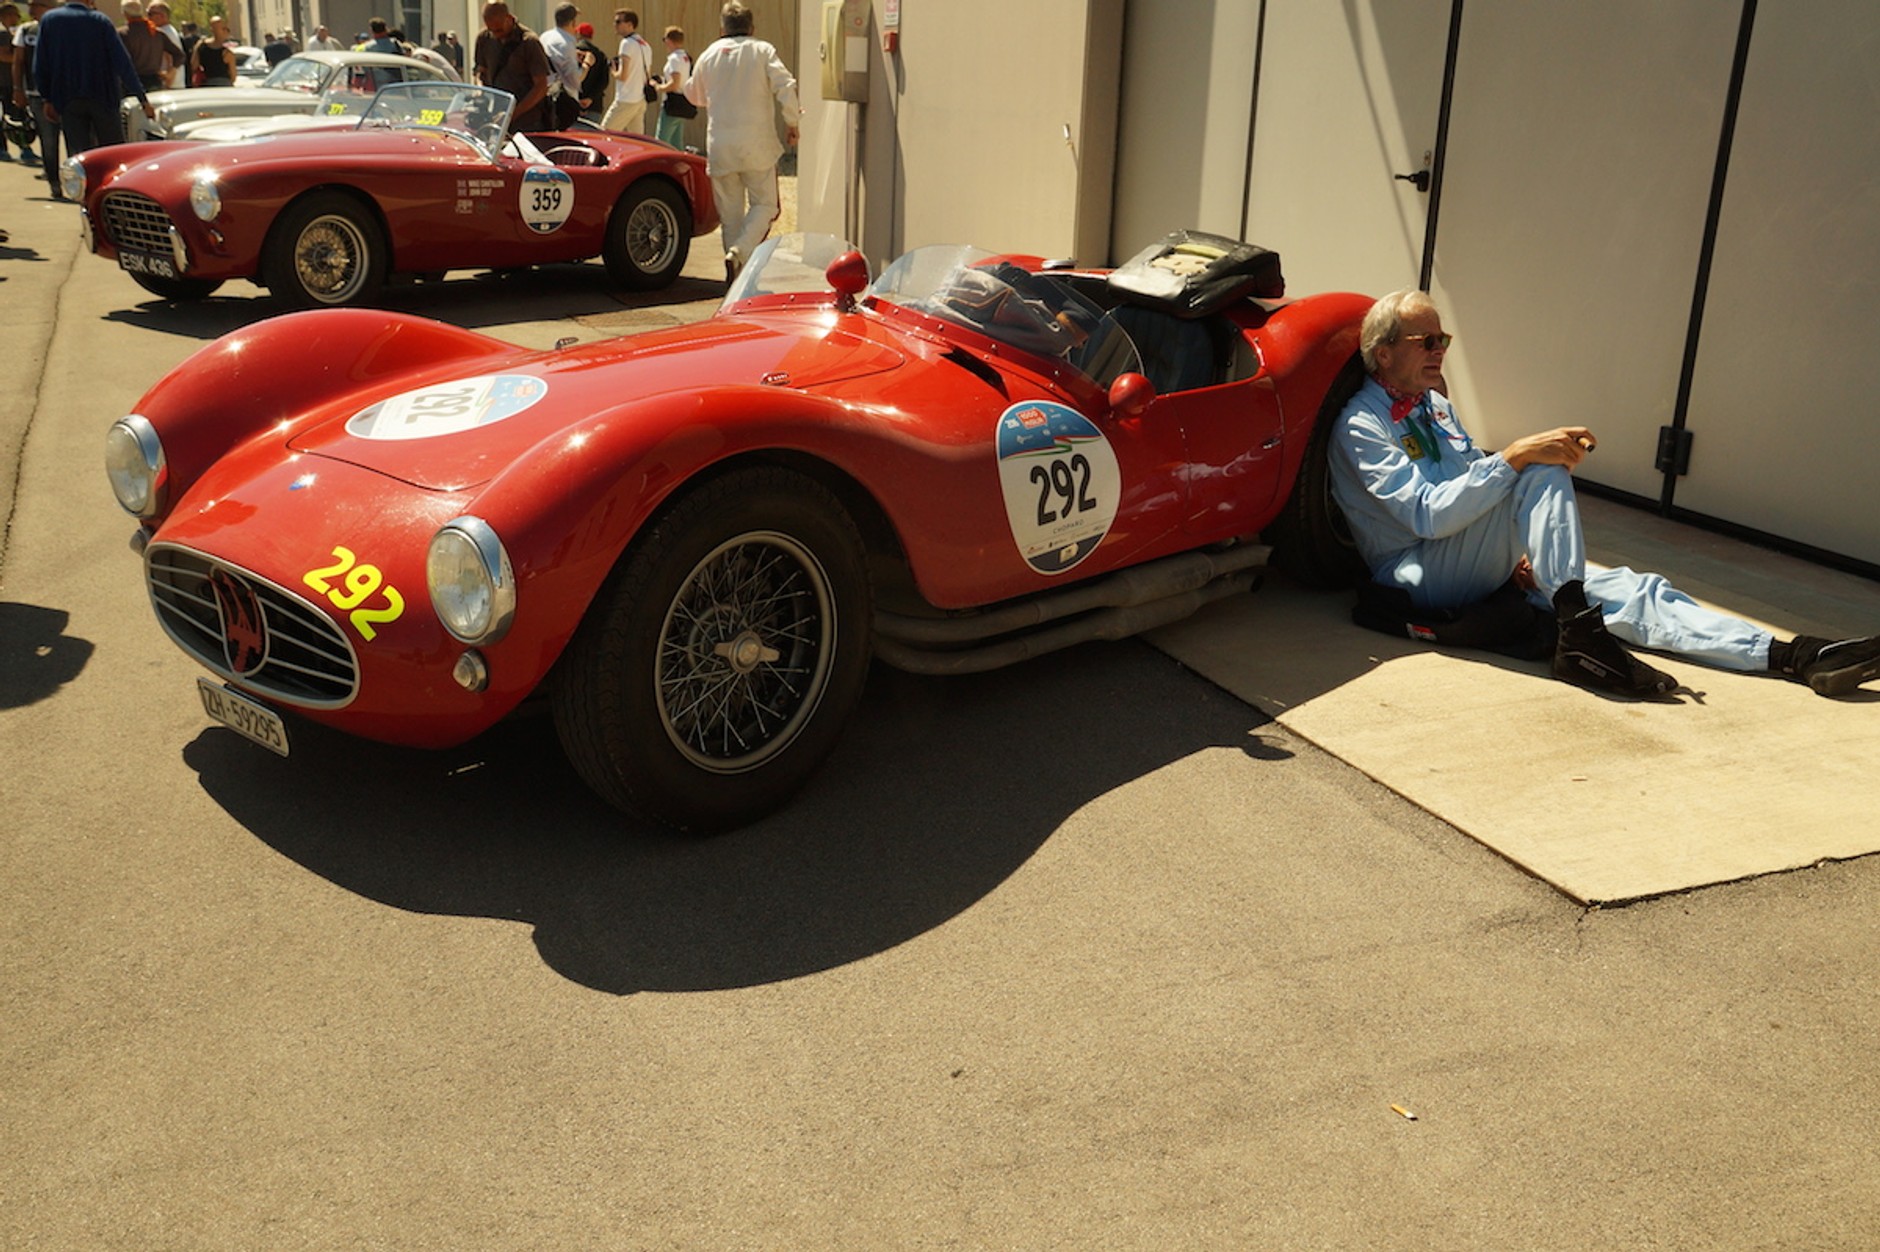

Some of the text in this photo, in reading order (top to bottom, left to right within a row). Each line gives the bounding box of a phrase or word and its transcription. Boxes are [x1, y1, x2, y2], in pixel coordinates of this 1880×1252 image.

[415, 109, 445, 126] 359
[532, 188, 562, 211] 359
[119, 251, 149, 273] ESK
[405, 387, 476, 425] 292
[1029, 453, 1097, 527] 292
[302, 545, 405, 642] 292
